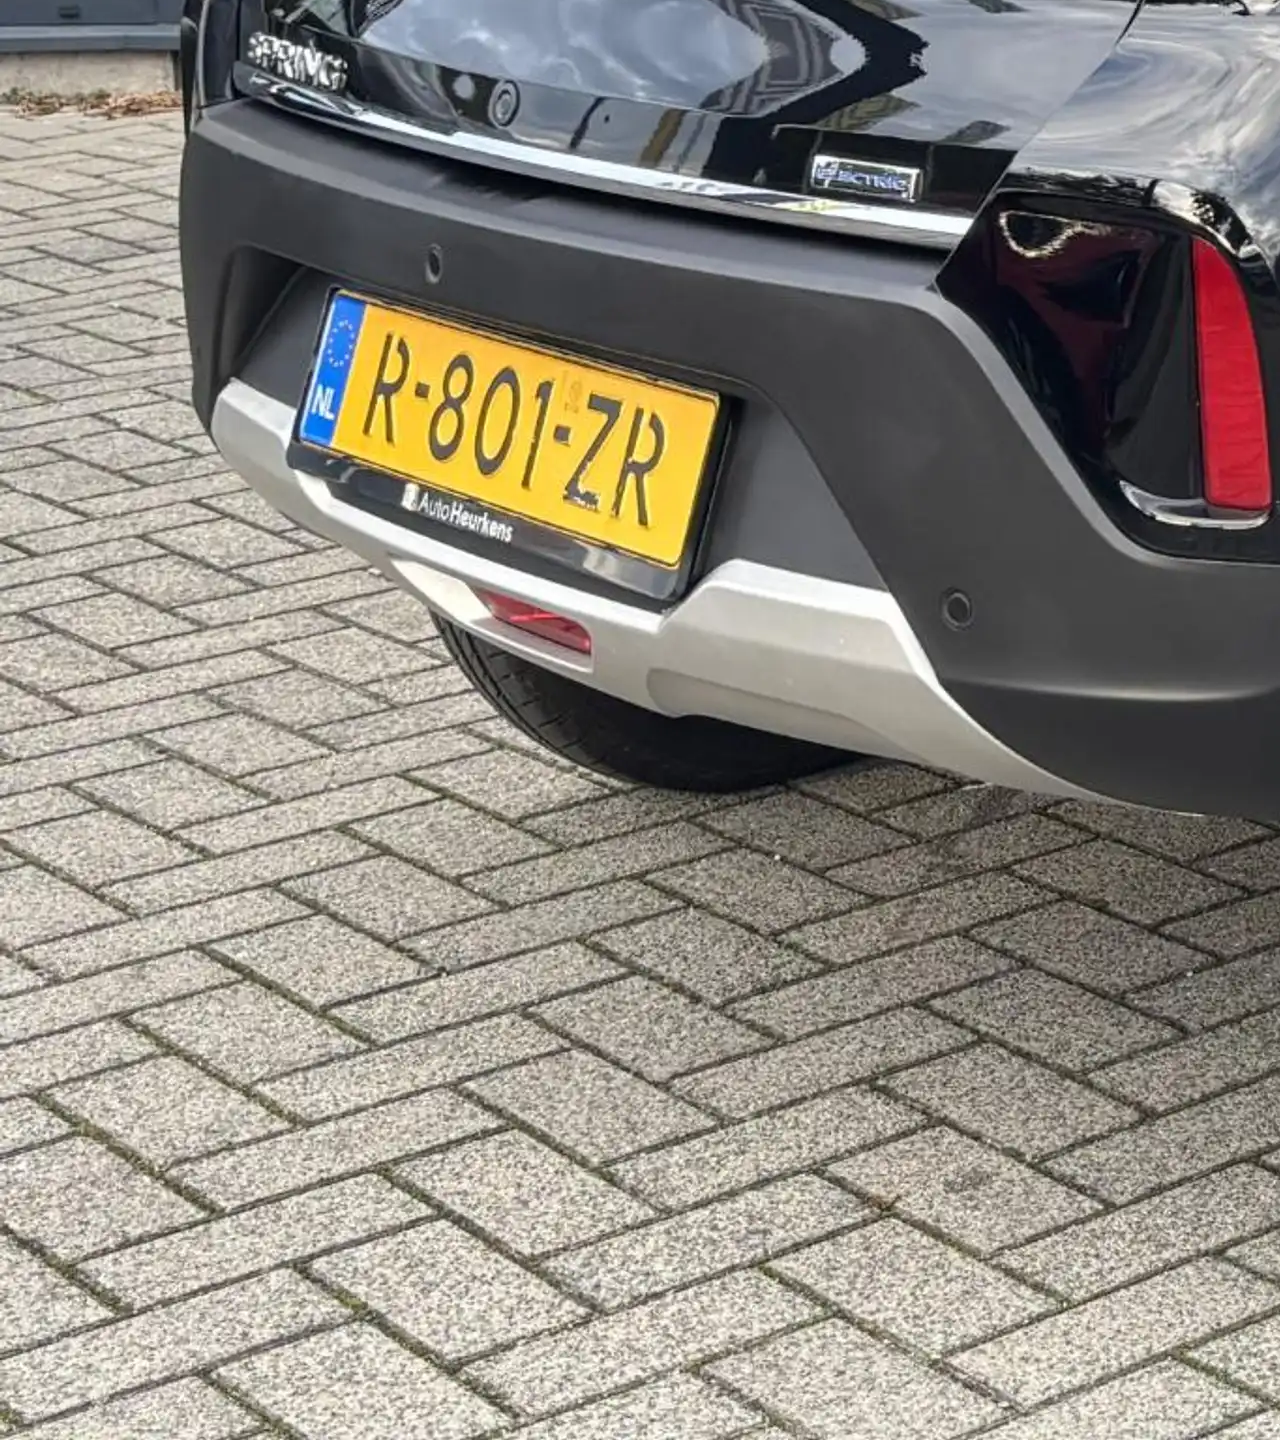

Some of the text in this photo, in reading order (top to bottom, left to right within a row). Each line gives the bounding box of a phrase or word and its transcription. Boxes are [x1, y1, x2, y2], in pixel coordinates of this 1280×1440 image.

[248, 31, 348, 90] SPRING
[312, 387, 334, 420] NL
[363, 332, 665, 528] R-801-ZR
